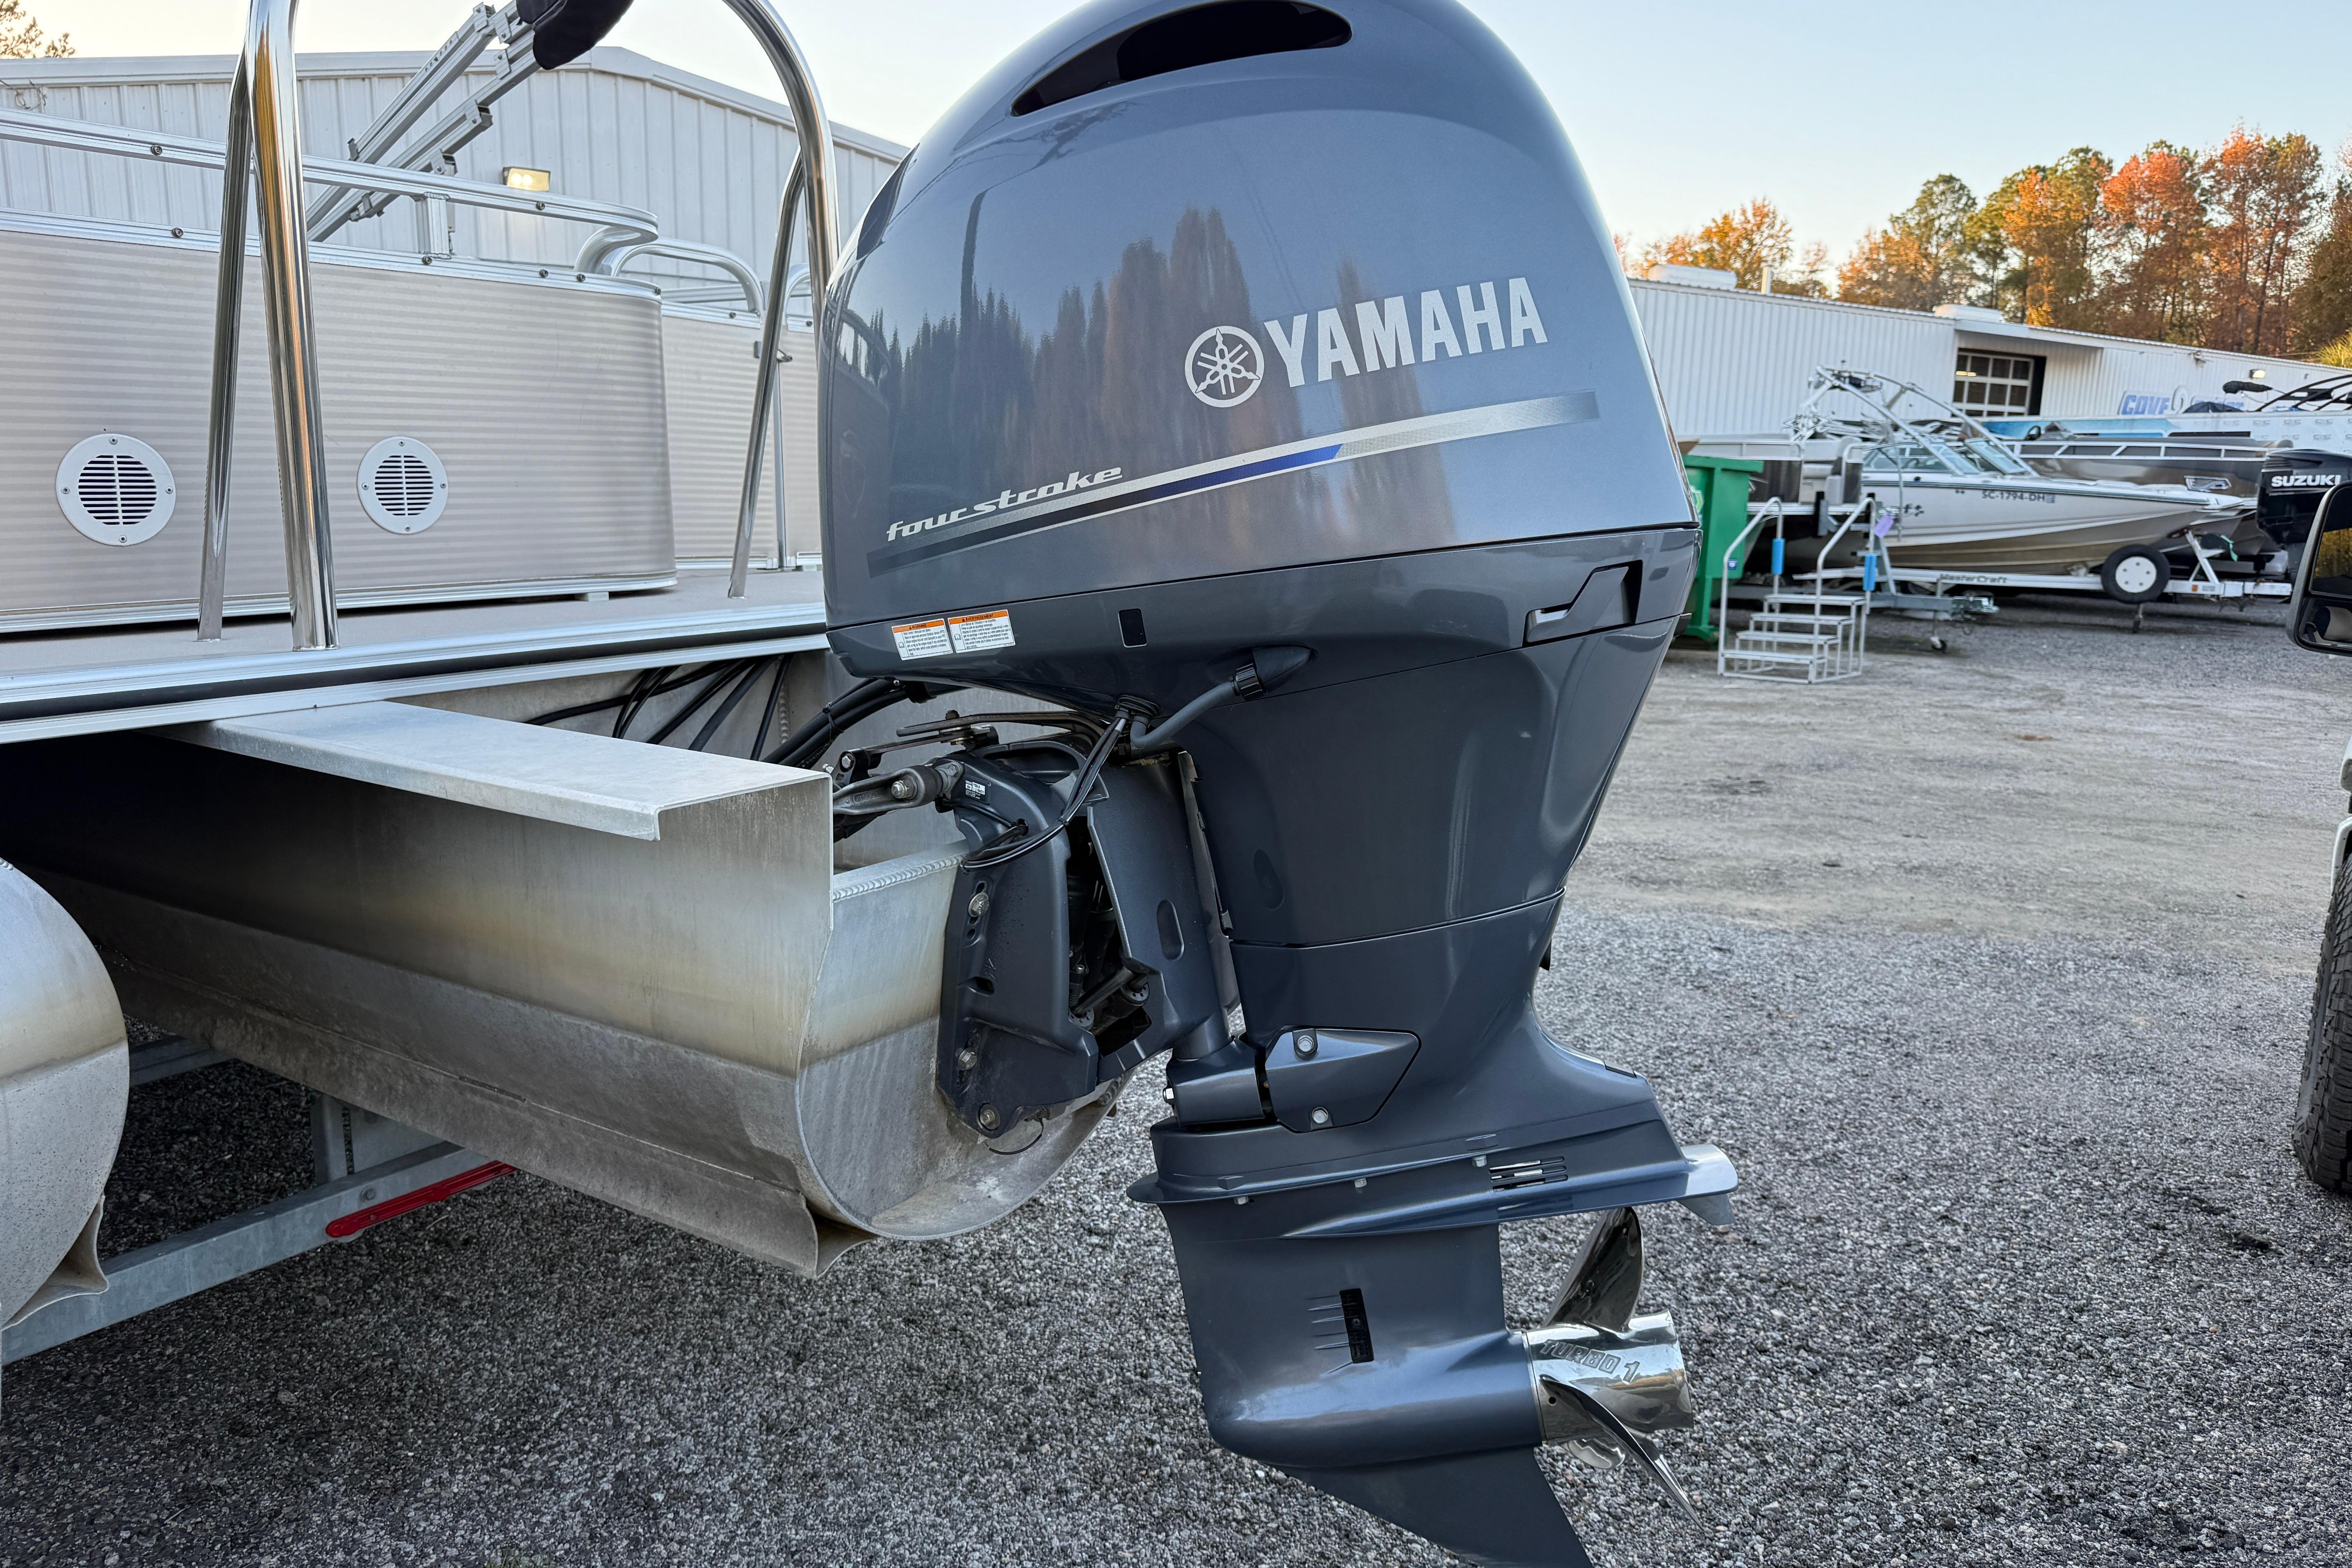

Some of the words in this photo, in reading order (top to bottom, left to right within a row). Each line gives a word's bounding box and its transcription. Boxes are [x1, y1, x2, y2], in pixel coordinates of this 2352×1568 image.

[1264, 277, 1548, 387] YAMAHA
[2121, 394, 2170, 415] COVE
[2271, 474, 2342, 487] SUZUKI
[1540, 1339, 1622, 1374] TURBO
[1623, 1360, 1640, 1383] 1
